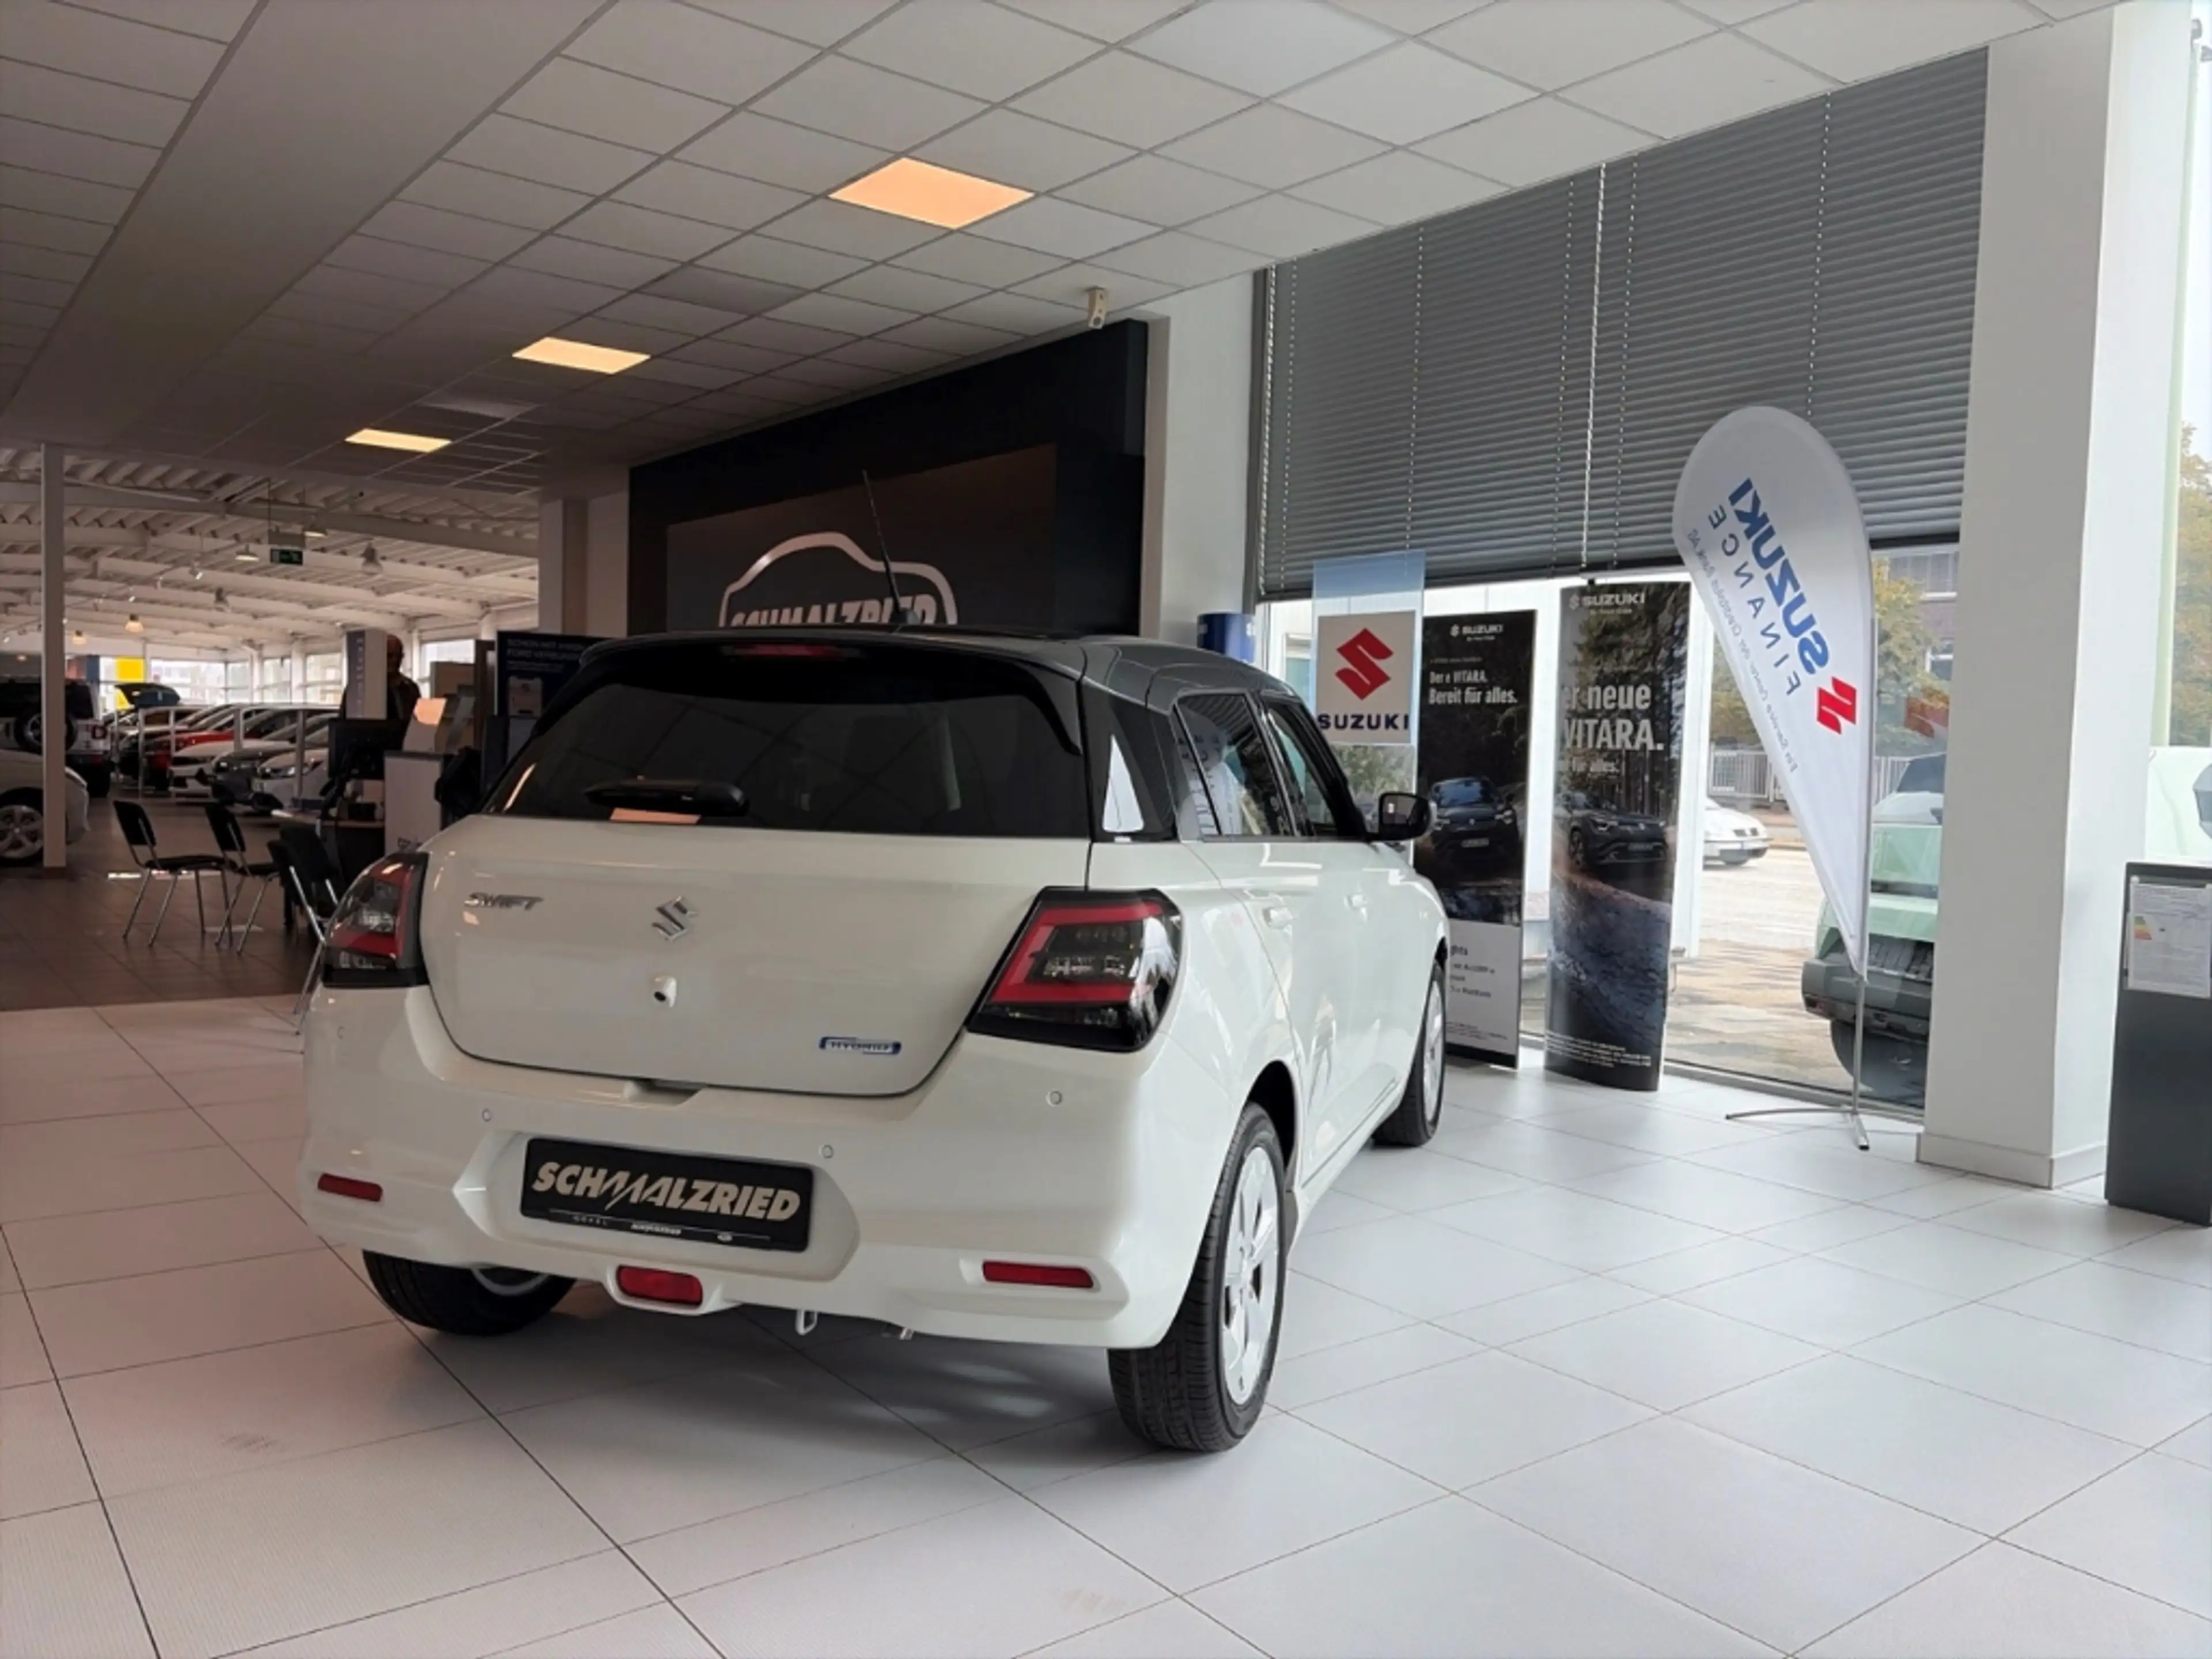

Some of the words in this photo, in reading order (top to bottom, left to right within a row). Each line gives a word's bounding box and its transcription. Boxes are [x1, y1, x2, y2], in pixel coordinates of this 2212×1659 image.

[1582, 592, 1646, 607] SUZUKI
[1461, 624, 1504, 635] SUZUKI
[1429, 687, 1462, 705] Bereit
[1464, 686, 1483, 704] für
[1485, 685, 1518, 704] alles.
[1587, 683, 1652, 710] neue
[1317, 713, 1410, 730] SUZUKI
[1563, 718, 1664, 751] VITARA.
[464, 892, 545, 911] SWIFT
[532, 1161, 801, 1222] SCHMALZRIED
